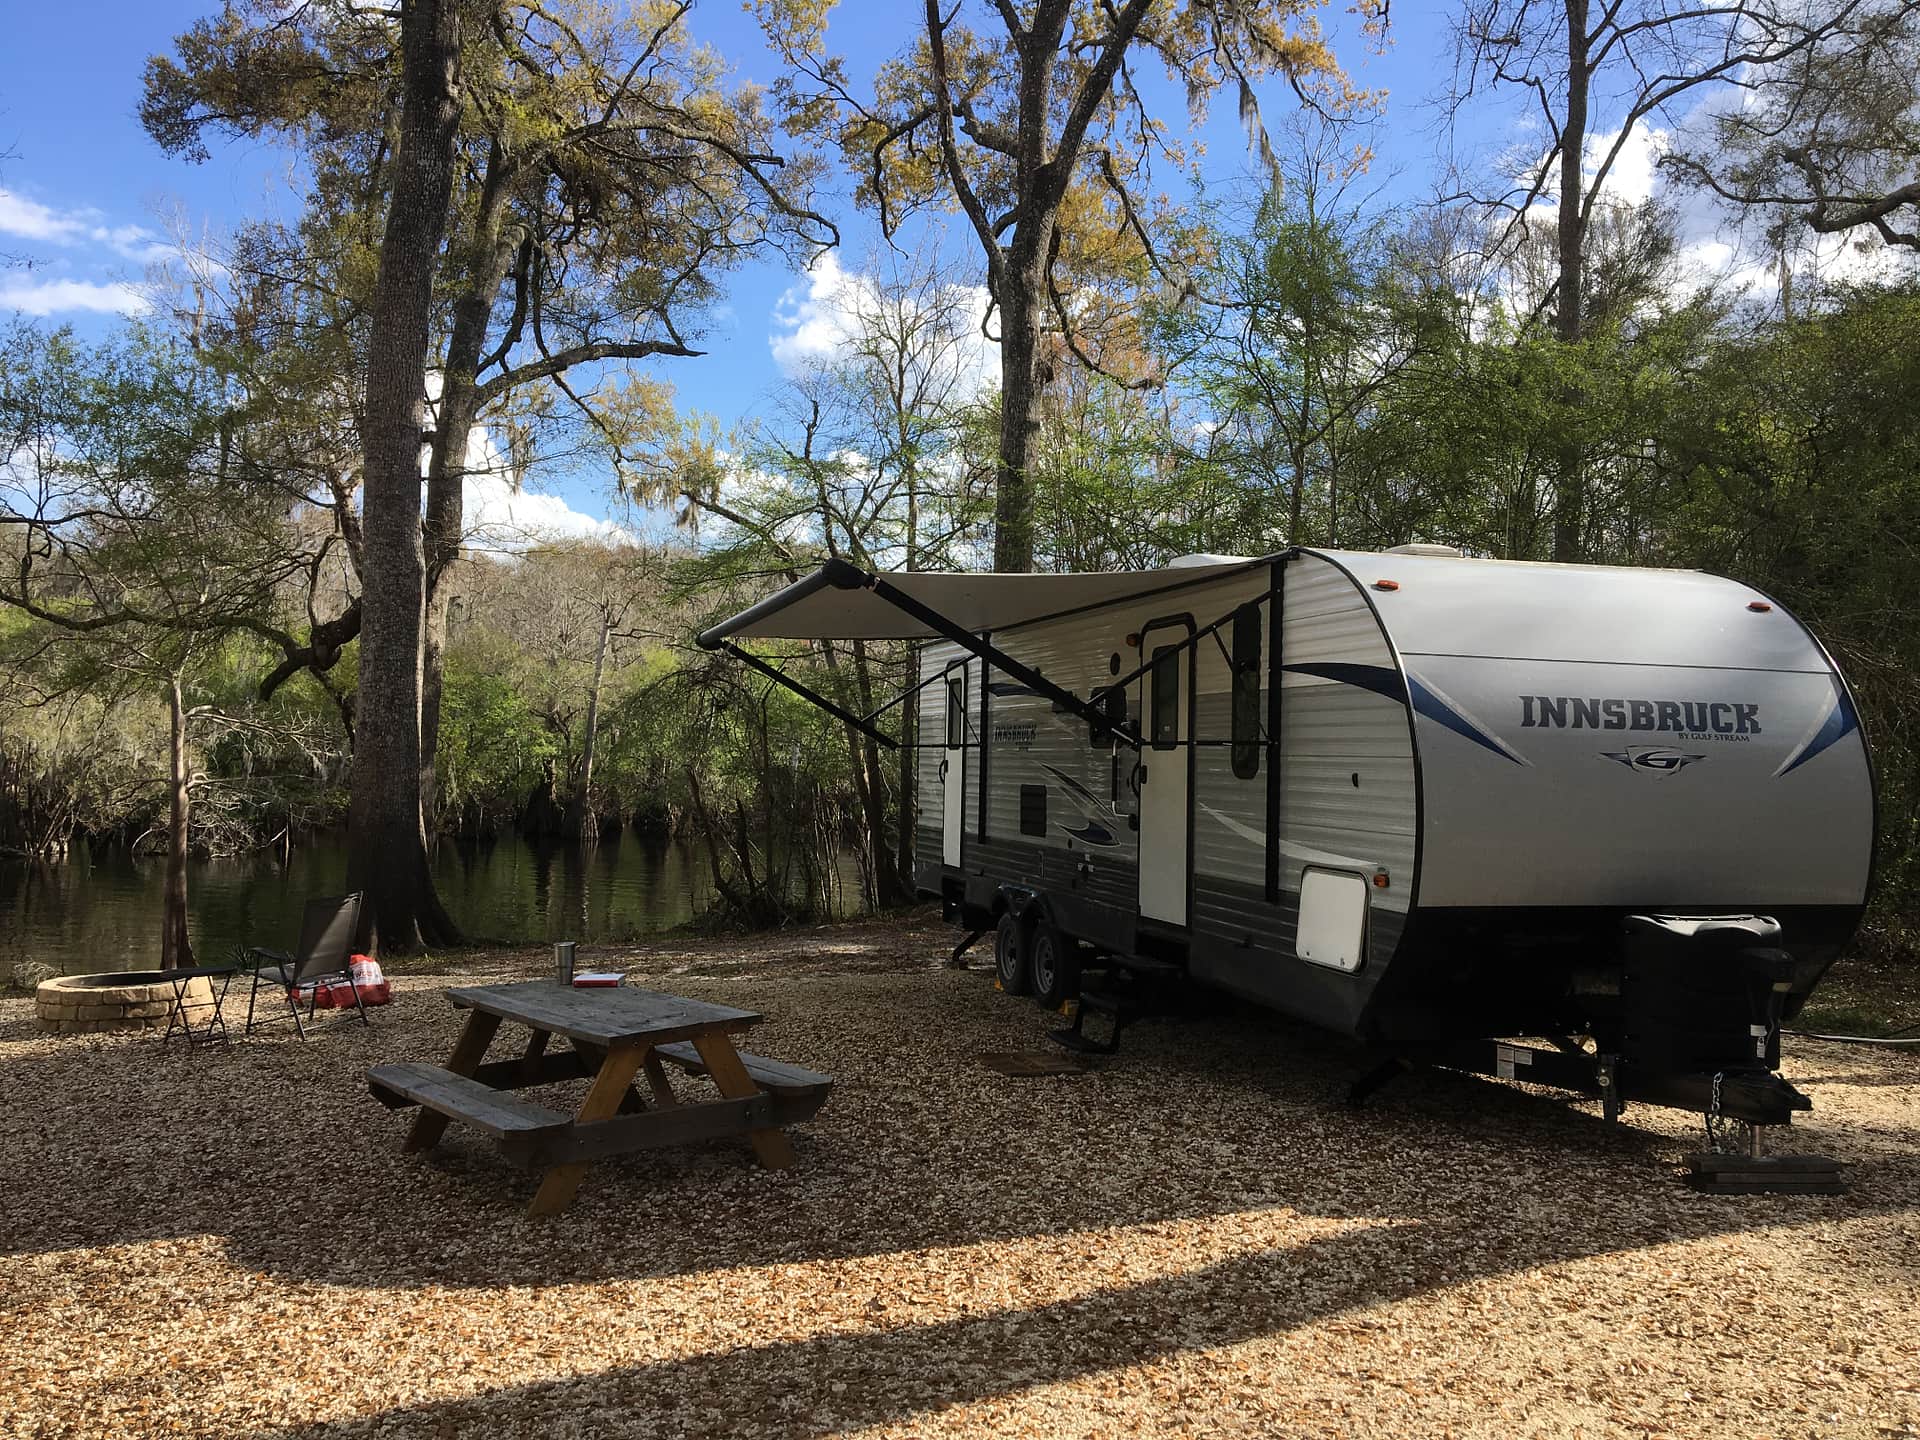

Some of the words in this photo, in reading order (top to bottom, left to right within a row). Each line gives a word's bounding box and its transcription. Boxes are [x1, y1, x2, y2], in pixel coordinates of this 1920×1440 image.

[1518, 695, 1762, 734] INNSBRUCK
[1678, 732, 1689, 740] BY
[1690, 732, 1713, 741] GULF
[1713, 733, 1751, 742] STREAM
